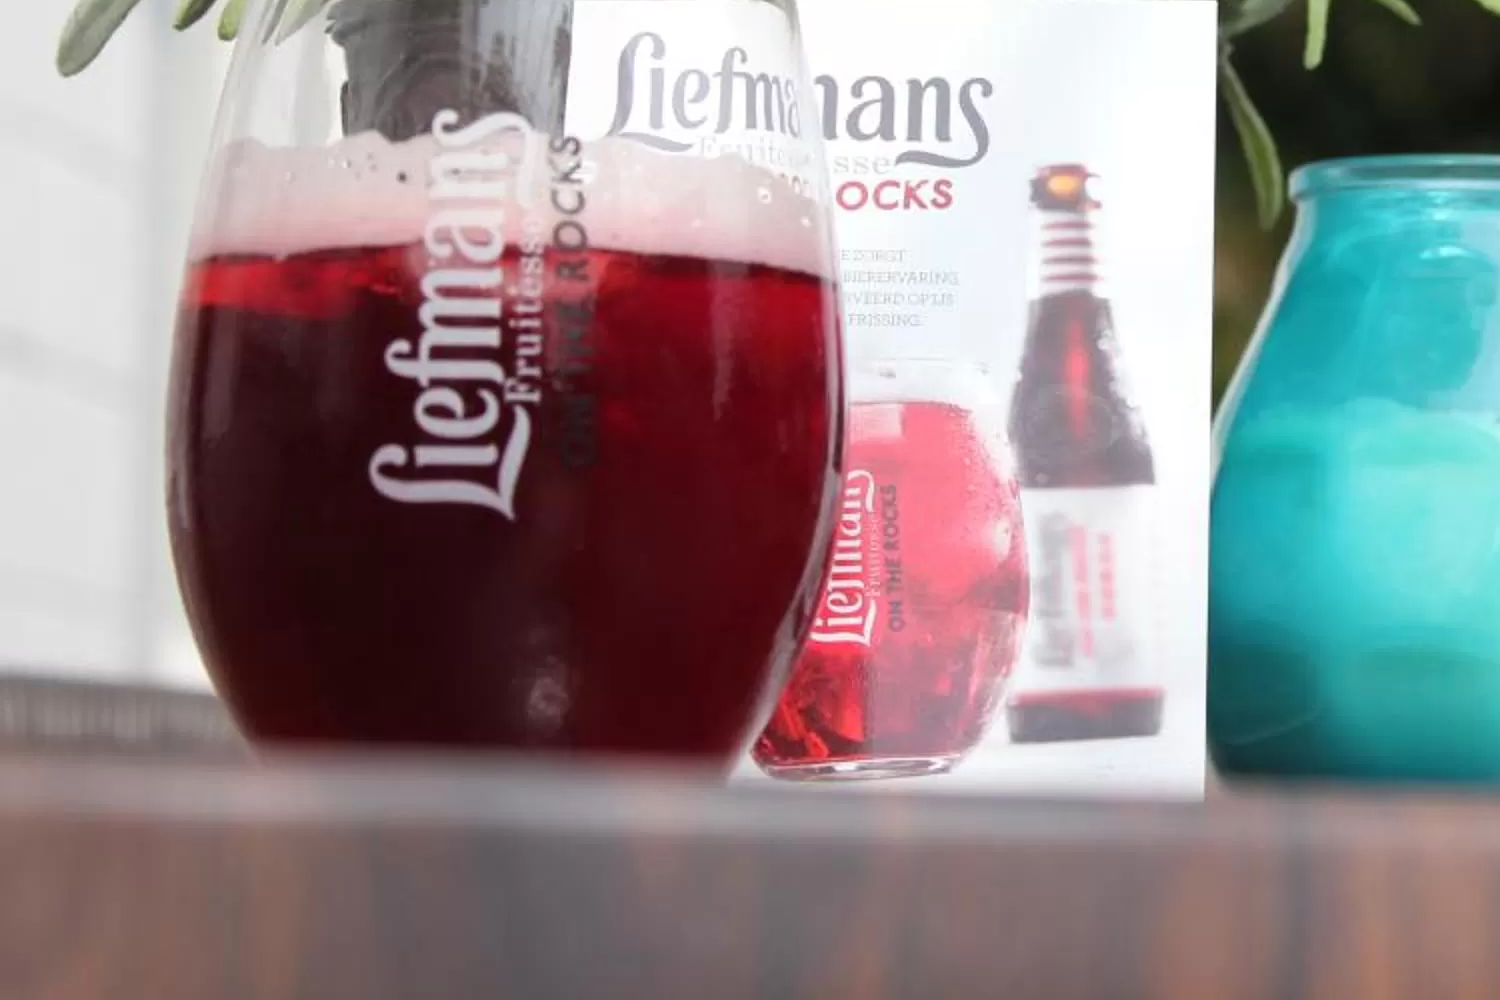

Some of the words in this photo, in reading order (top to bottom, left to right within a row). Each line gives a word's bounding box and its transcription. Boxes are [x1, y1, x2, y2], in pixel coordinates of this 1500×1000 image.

[548, 135, 589, 283] ROCKS
[835, 178, 954, 211] OCKS
[367, 107, 533, 521] Liefmans
[879, 483, 901, 552] ROCKS
